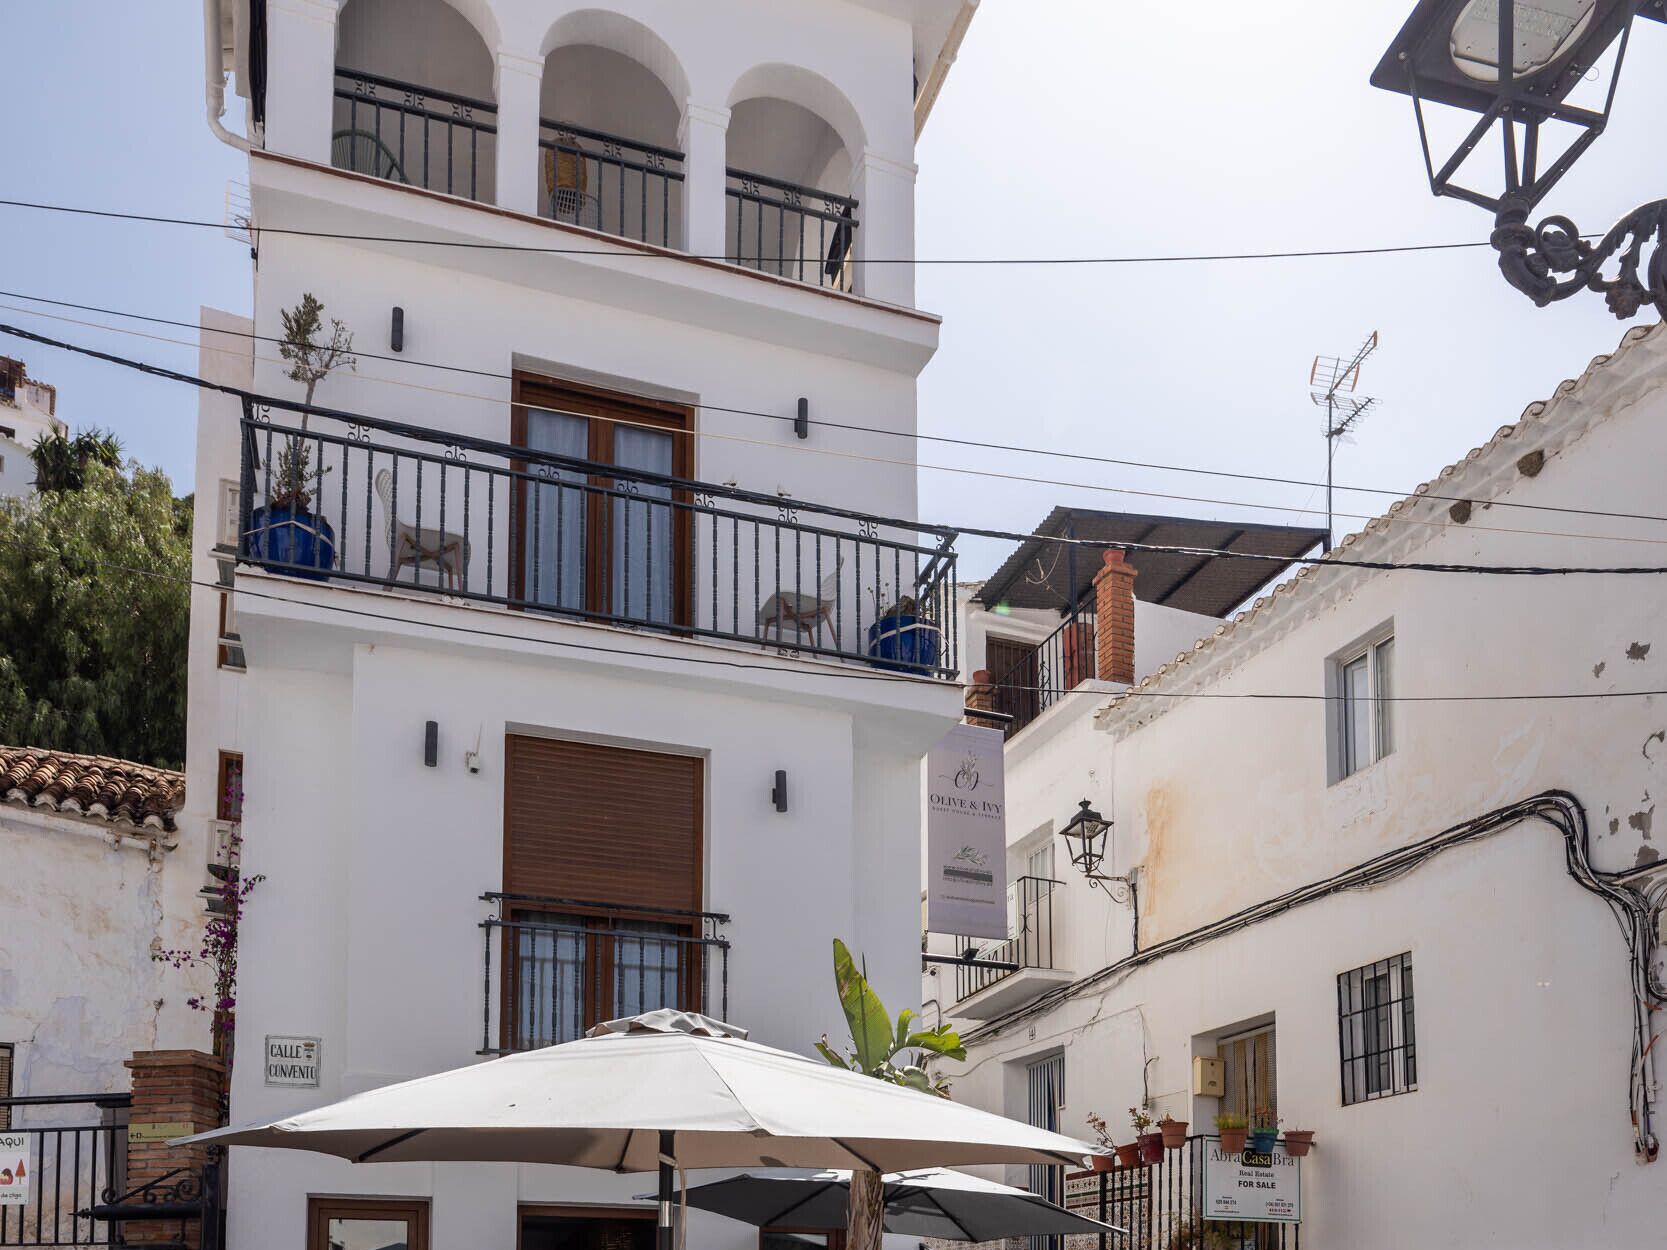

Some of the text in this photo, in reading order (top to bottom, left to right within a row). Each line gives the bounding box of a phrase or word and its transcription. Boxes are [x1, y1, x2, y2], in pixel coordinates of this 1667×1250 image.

[930, 793, 1002, 814] OLIVE & IVY
[270, 1043, 302, 1059] CALLE
[269, 1063, 317, 1080] CONVENTO
[1239, 1169, 1275, 1178] Real Estate
[1238, 1180, 1276, 1190] FOR SALE
